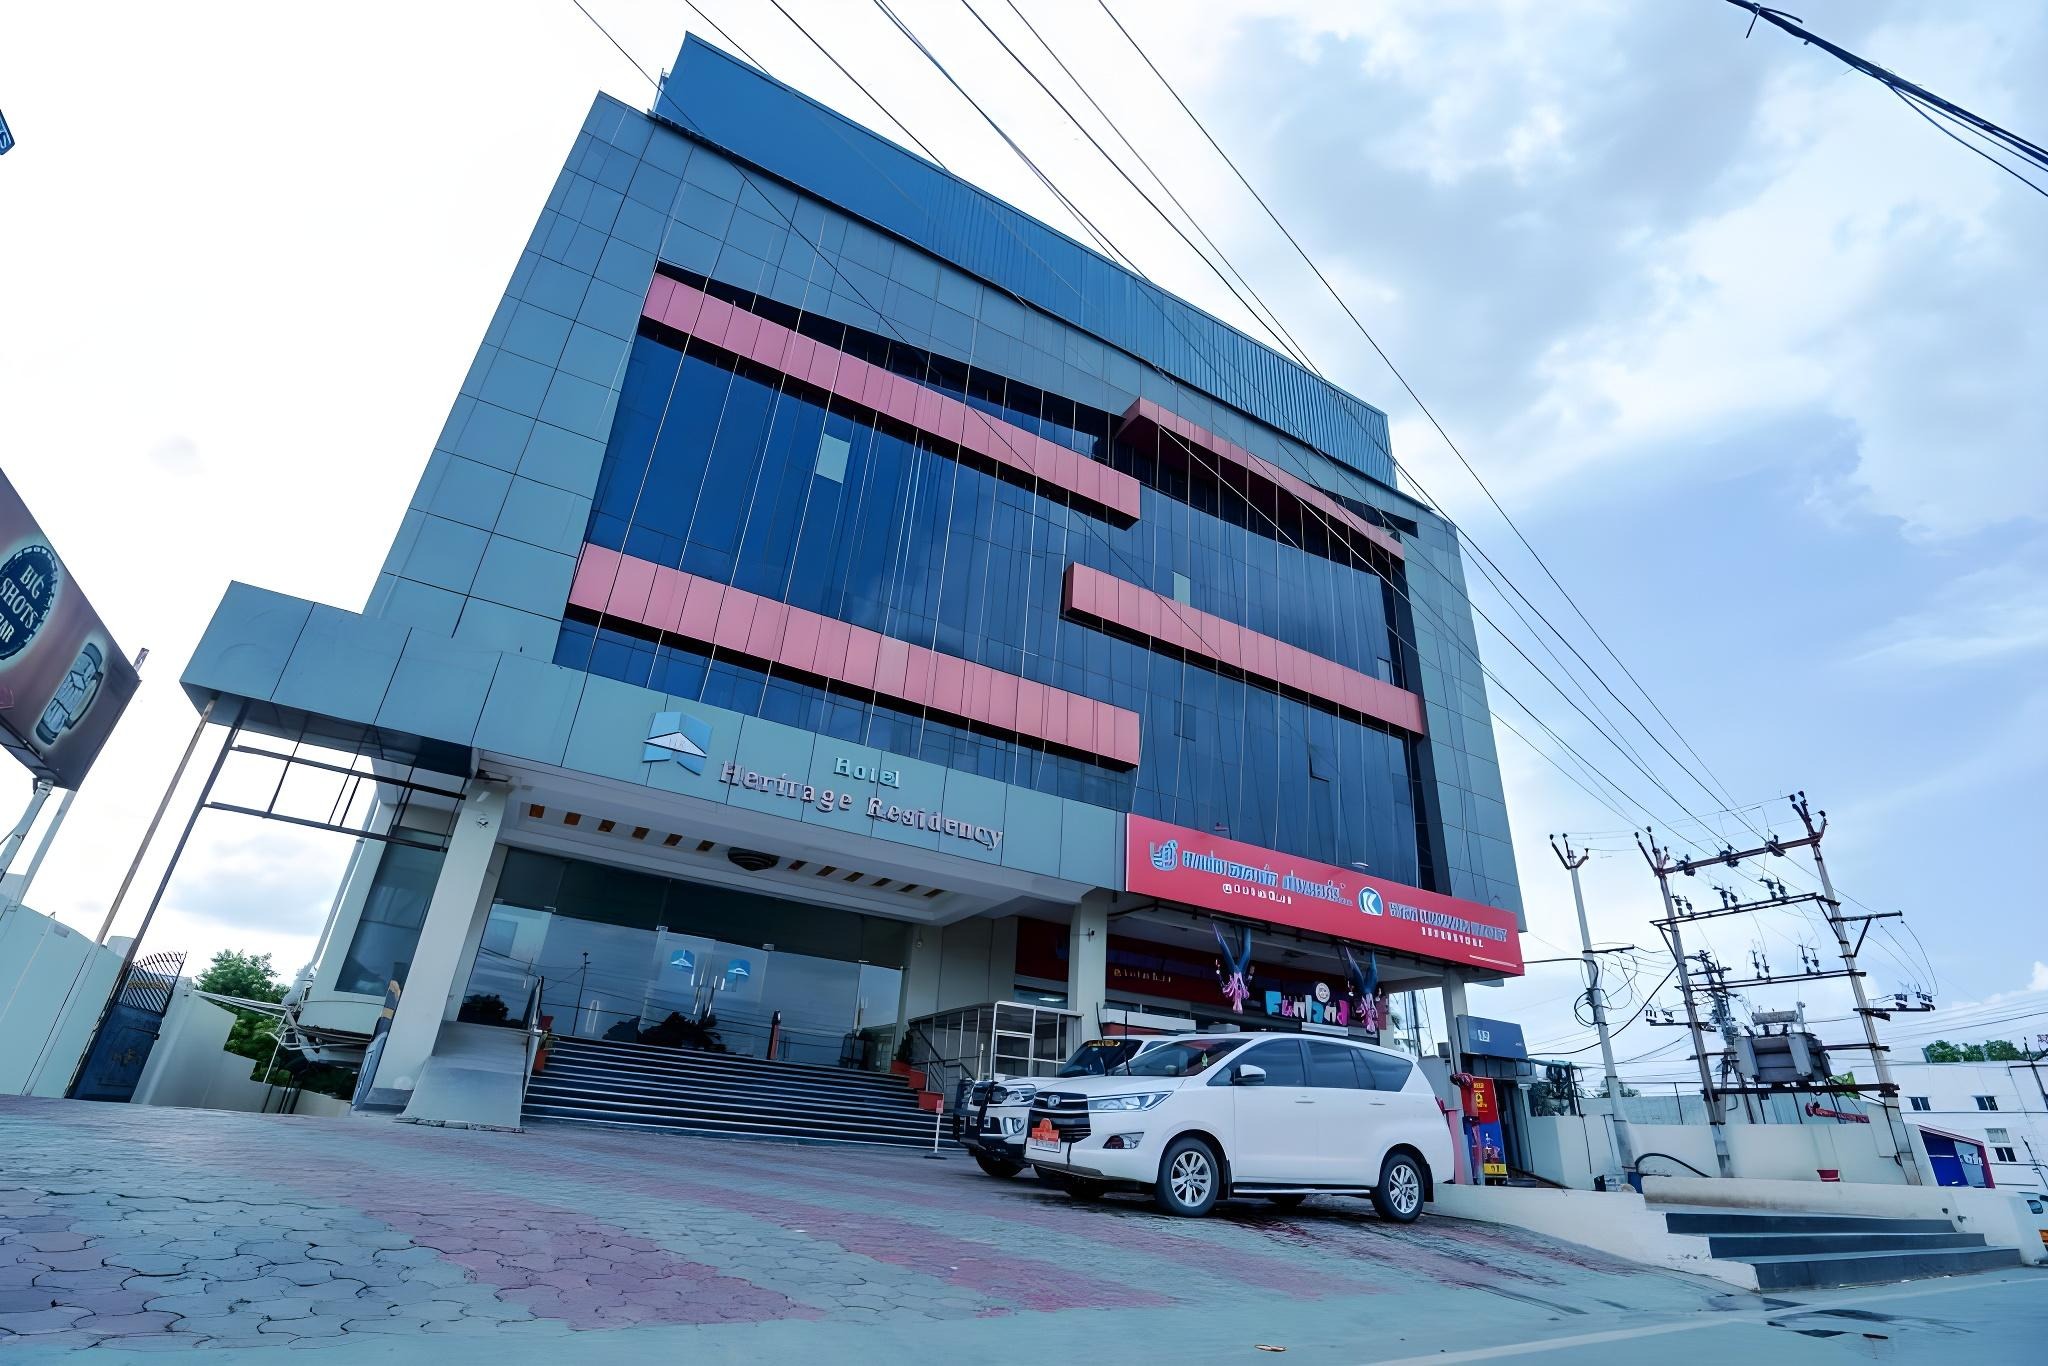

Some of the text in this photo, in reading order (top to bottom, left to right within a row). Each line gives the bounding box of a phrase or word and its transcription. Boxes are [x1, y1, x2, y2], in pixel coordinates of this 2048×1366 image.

[0, 578, 38, 629] SHOTS
[20, 565, 44, 600] BIG
[834, 757, 899, 788] Hotel
[719, 760, 1003, 850] Heritage Residency
